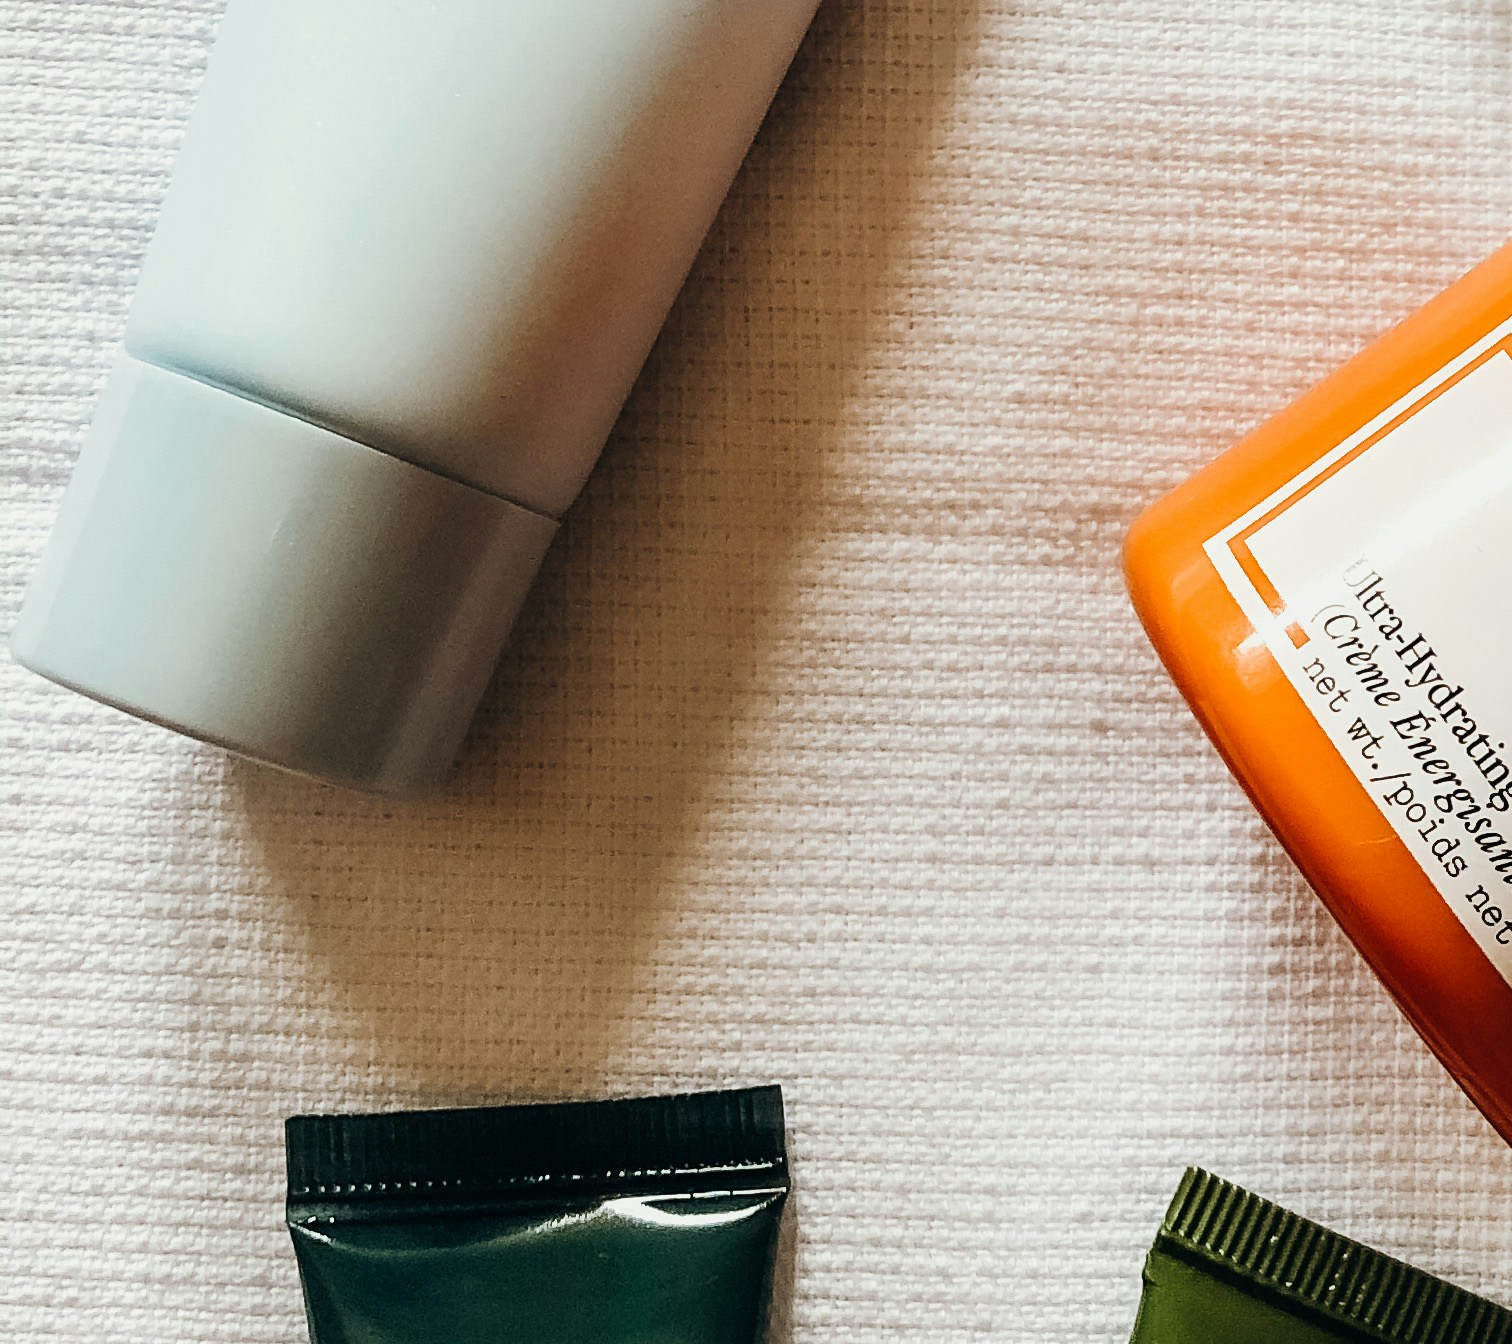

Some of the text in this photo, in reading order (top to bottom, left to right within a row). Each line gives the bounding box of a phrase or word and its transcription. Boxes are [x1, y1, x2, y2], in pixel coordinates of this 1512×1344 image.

[1311, 604, 1401, 707] (Crème
[1303, 657, 1350, 712] net
[1347, 717, 1469, 879] wt./poids
